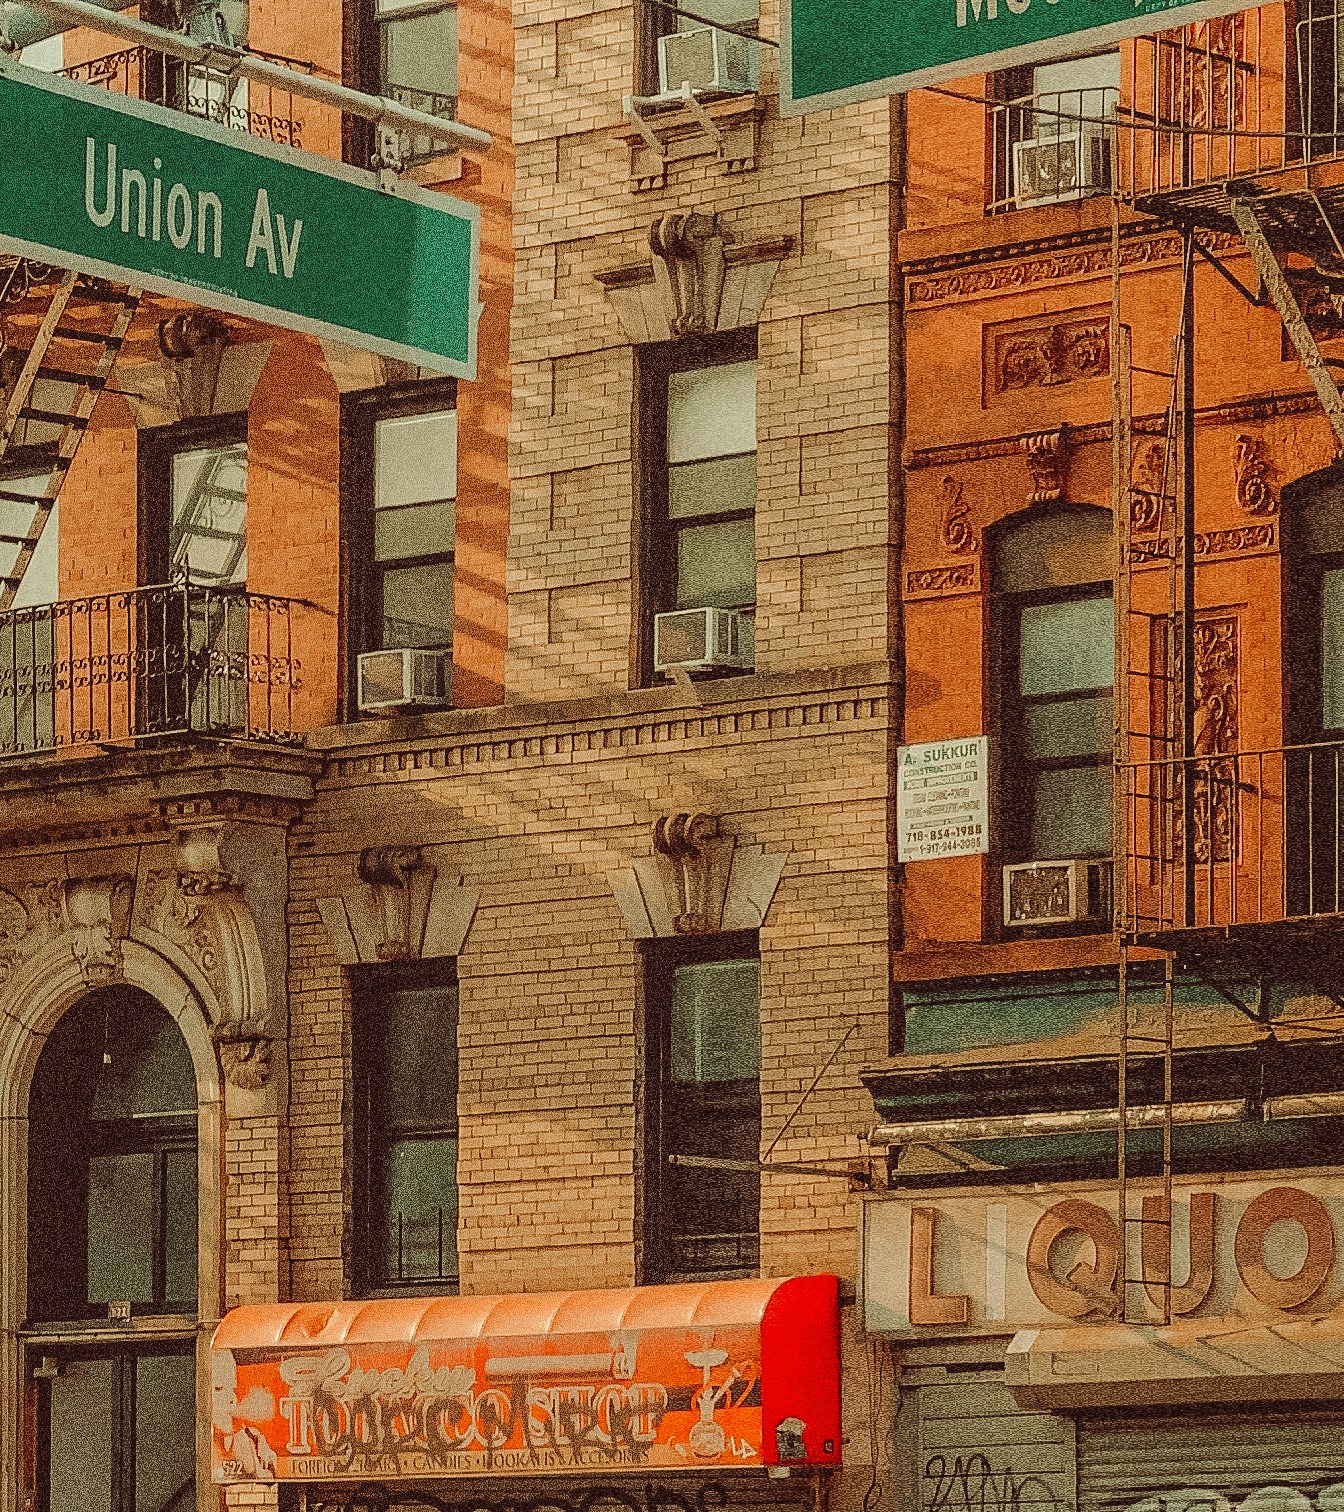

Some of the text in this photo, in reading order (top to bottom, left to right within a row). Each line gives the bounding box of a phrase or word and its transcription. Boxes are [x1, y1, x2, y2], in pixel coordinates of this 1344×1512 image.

[84, 137, 304, 279] Union Av
[923, 743, 979, 763] SUKKUR
[223, 1460, 244, 1475] 522
